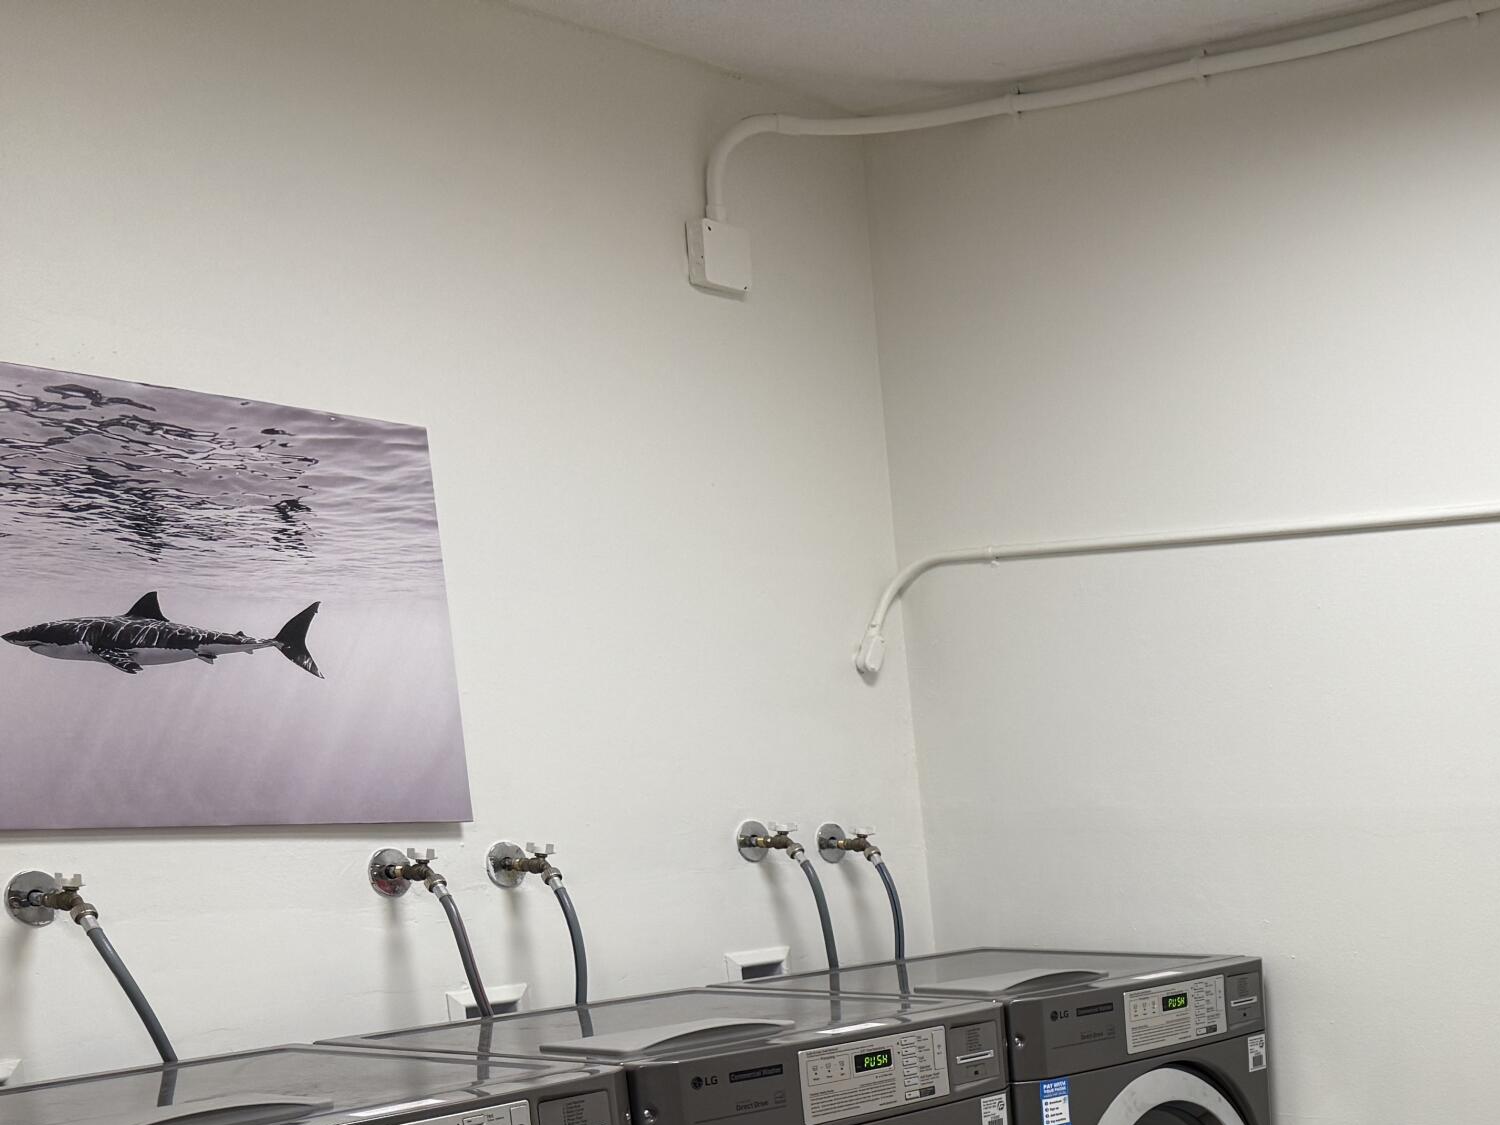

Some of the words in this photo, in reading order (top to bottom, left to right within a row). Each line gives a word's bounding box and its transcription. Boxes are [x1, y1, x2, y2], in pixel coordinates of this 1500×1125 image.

[1168, 996, 1185, 1008] PUSH
[1060, 1010, 1069, 1019] LG
[864, 1054, 888, 1068] PUSH
[704, 1076, 718, 1086] LG
